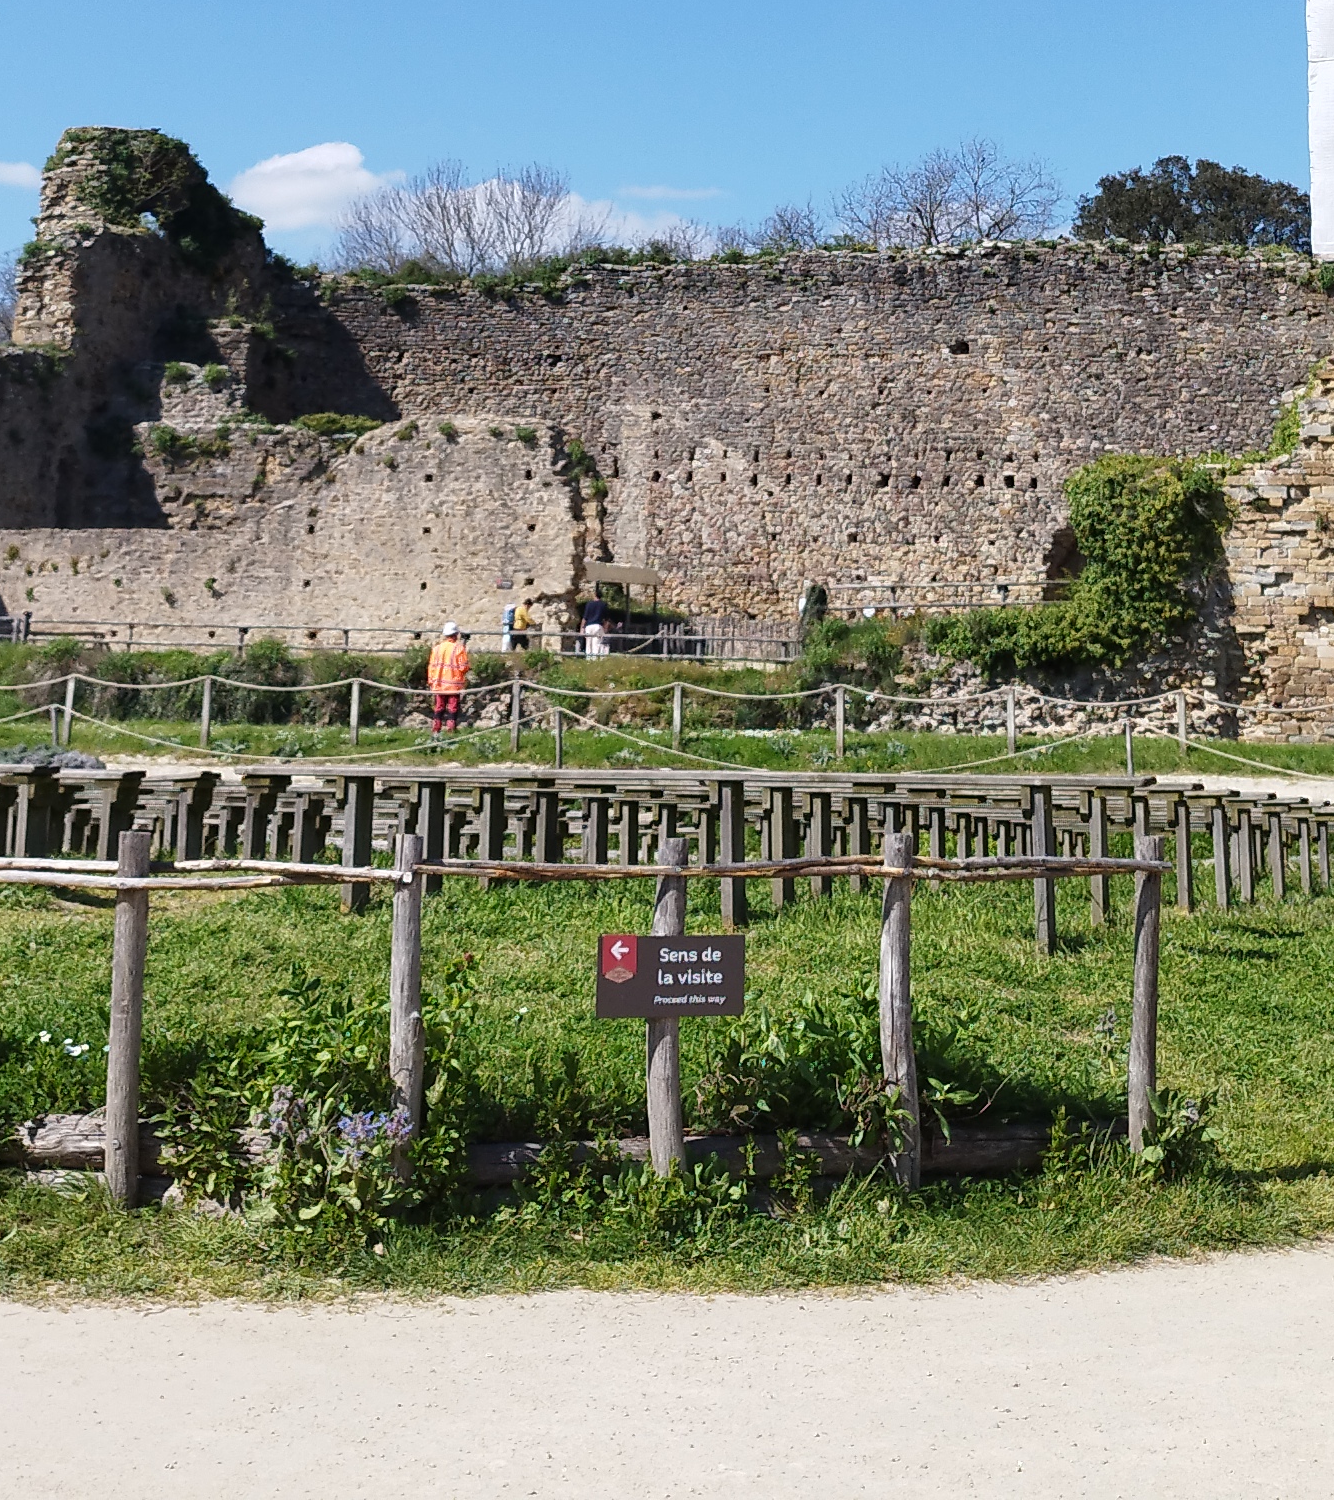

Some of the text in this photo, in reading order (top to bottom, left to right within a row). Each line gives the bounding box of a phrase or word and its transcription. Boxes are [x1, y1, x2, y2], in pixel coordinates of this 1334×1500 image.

[659, 946, 722, 963] Sens de
[657, 968, 724, 986] la visite
[707, 995, 727, 1006] way
